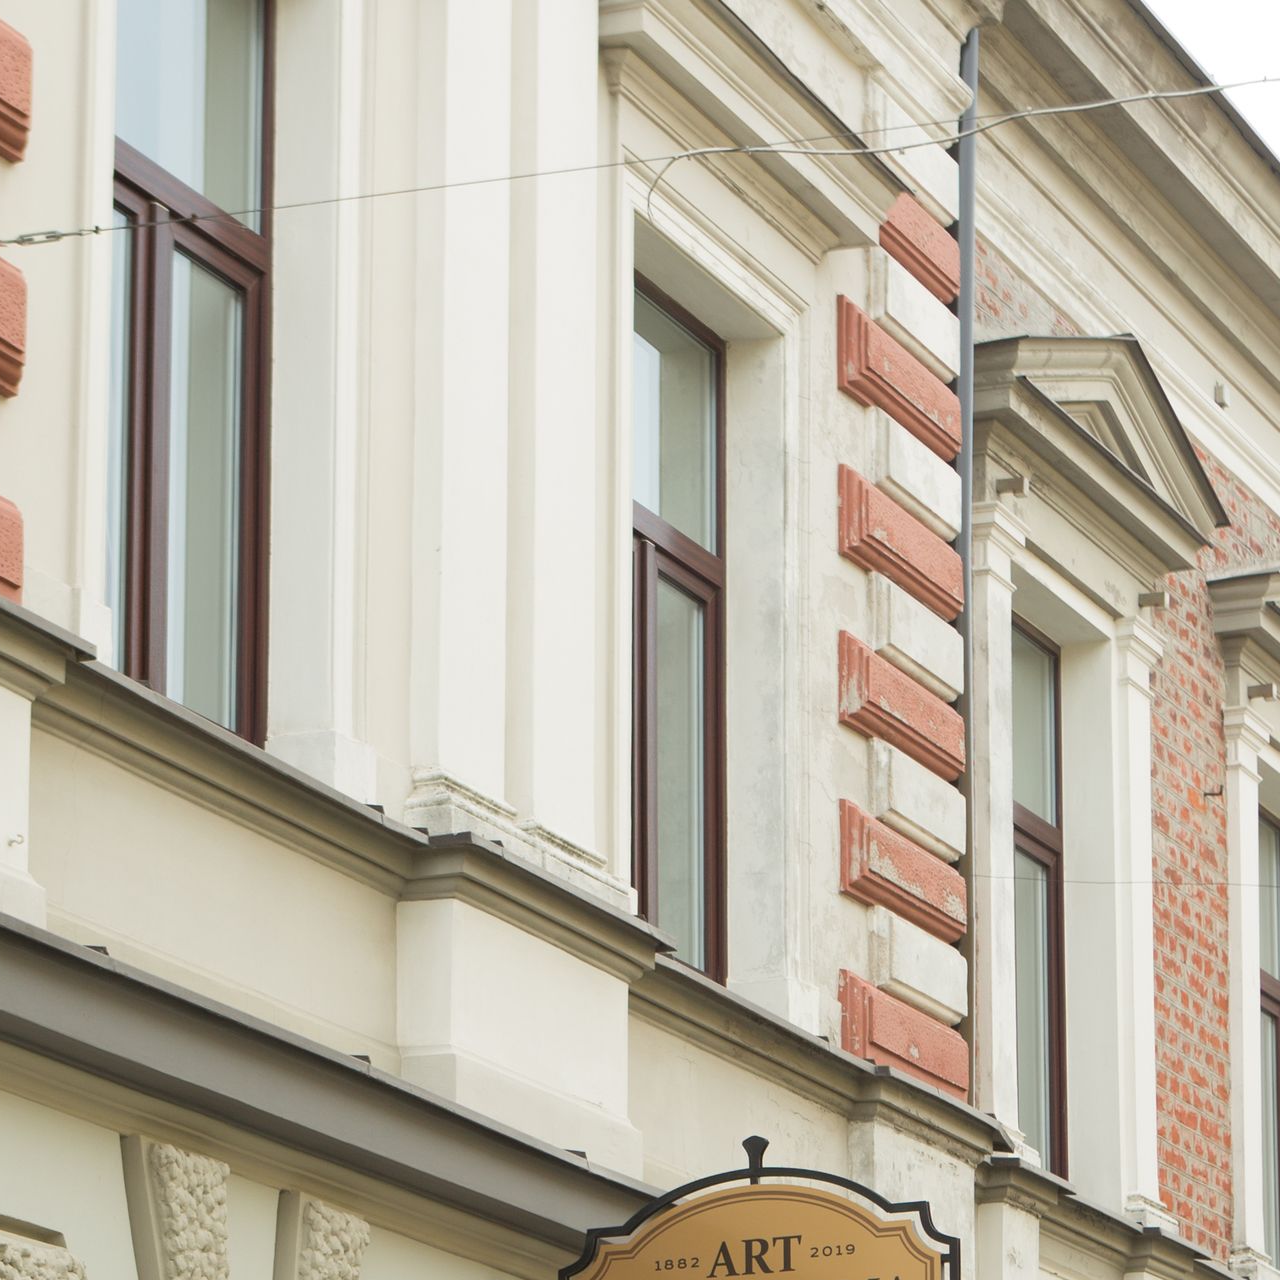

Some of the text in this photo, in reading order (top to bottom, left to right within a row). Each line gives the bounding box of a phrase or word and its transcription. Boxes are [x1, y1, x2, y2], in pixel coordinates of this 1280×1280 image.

[655, 1235, 856, 1278] 1882 ART 2019
